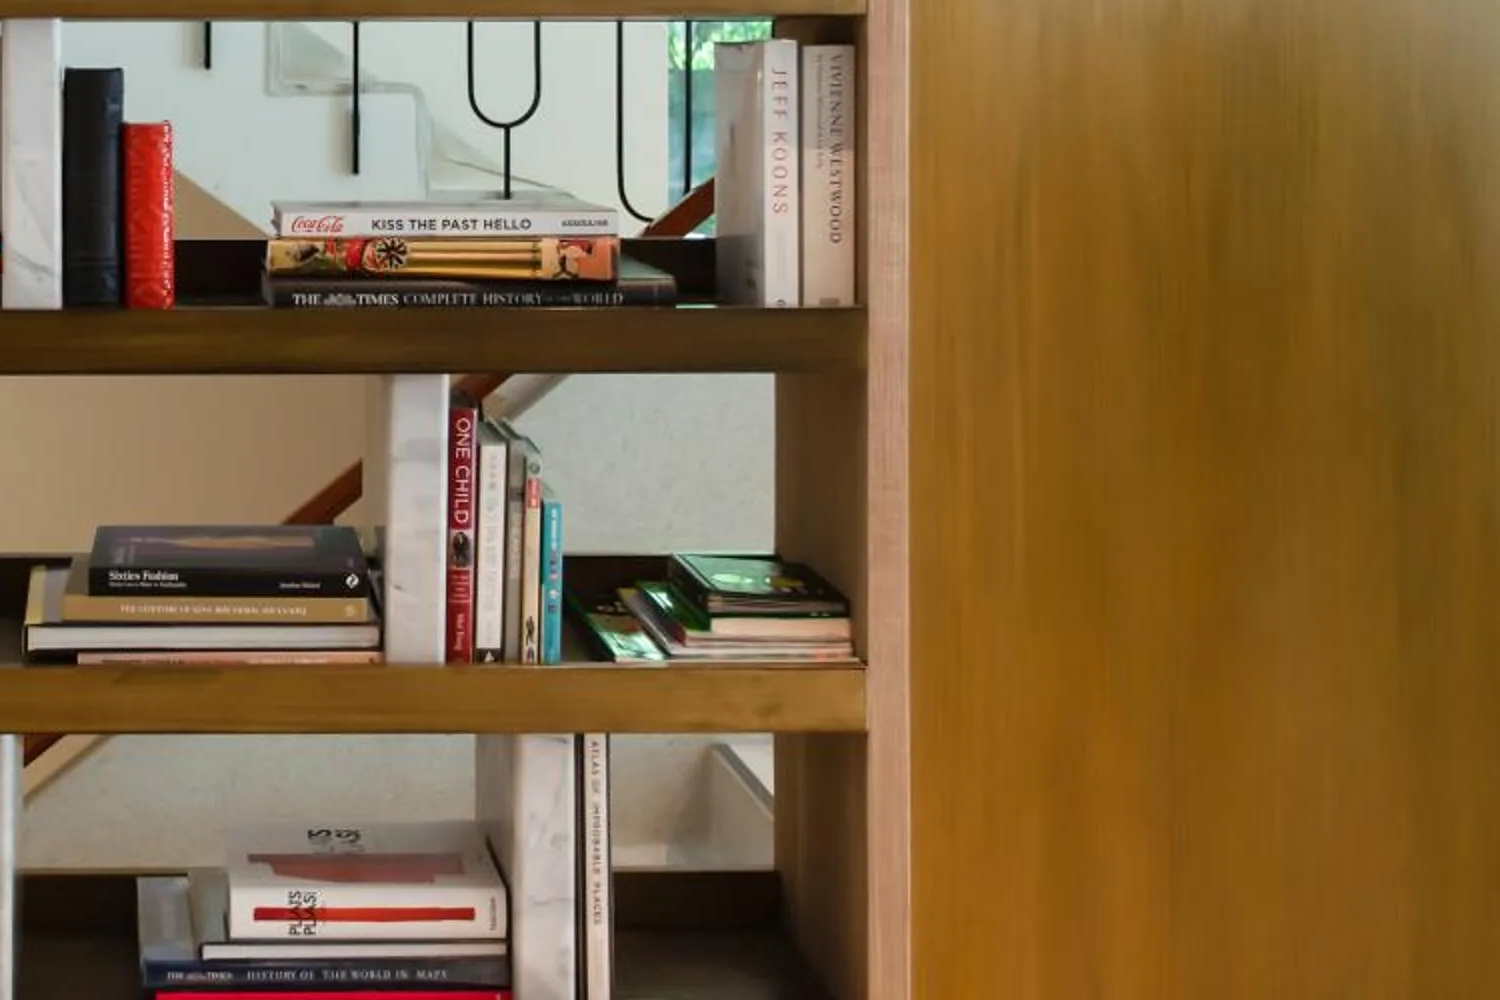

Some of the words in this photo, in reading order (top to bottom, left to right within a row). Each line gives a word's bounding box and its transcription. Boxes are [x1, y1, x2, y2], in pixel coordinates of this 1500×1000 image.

[772, 68, 789, 120] JEFF
[830, 53, 844, 135] VIVIENNE
[772, 131, 789, 214] KOONS
[829, 142, 843, 245] WESTWOOD
[371, 219, 404, 231] KISS
[410, 219, 437, 231] THE
[442, 219, 477, 231] PAST
[483, 219, 532, 231] HELLO
[292, 293, 322, 306] THE
[356, 293, 399, 305] TIMES
[403, 293, 477, 305] COMPLETE
[483, 293, 542, 305] HISTORY
[454, 417, 471, 459] ONE
[453, 464, 472, 524] CHILD
[108, 570, 141, 581] Sixties
[142, 569, 179, 581] Fashion
[591, 741, 600, 775] ATLAS
[247, 970, 296, 981] HISTORY
[323, 970, 346, 981] THE
[351, 970, 391, 981] WORLD
[395, 970, 408, 981] IN
[416, 969, 448, 980] MAPS
